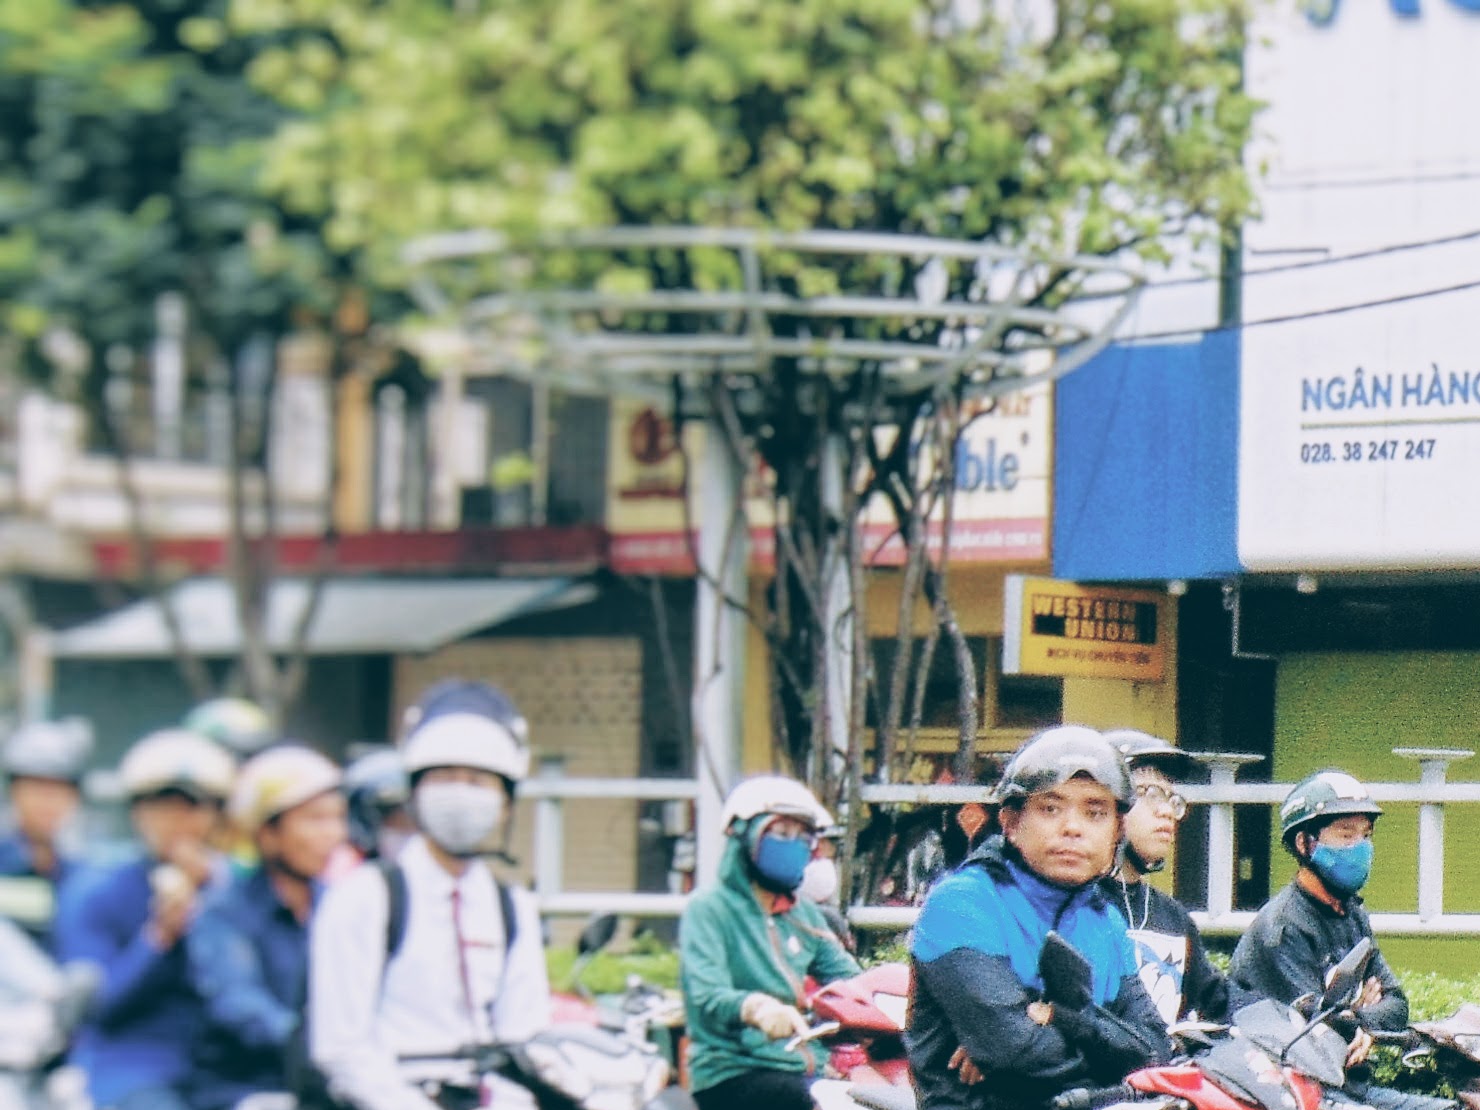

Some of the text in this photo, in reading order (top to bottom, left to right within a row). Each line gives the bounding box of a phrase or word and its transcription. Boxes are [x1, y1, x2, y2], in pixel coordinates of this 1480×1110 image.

[1300, 365, 1393, 412] NGÂN
[1300, 438, 1437, 464] 028. 38 247 247
